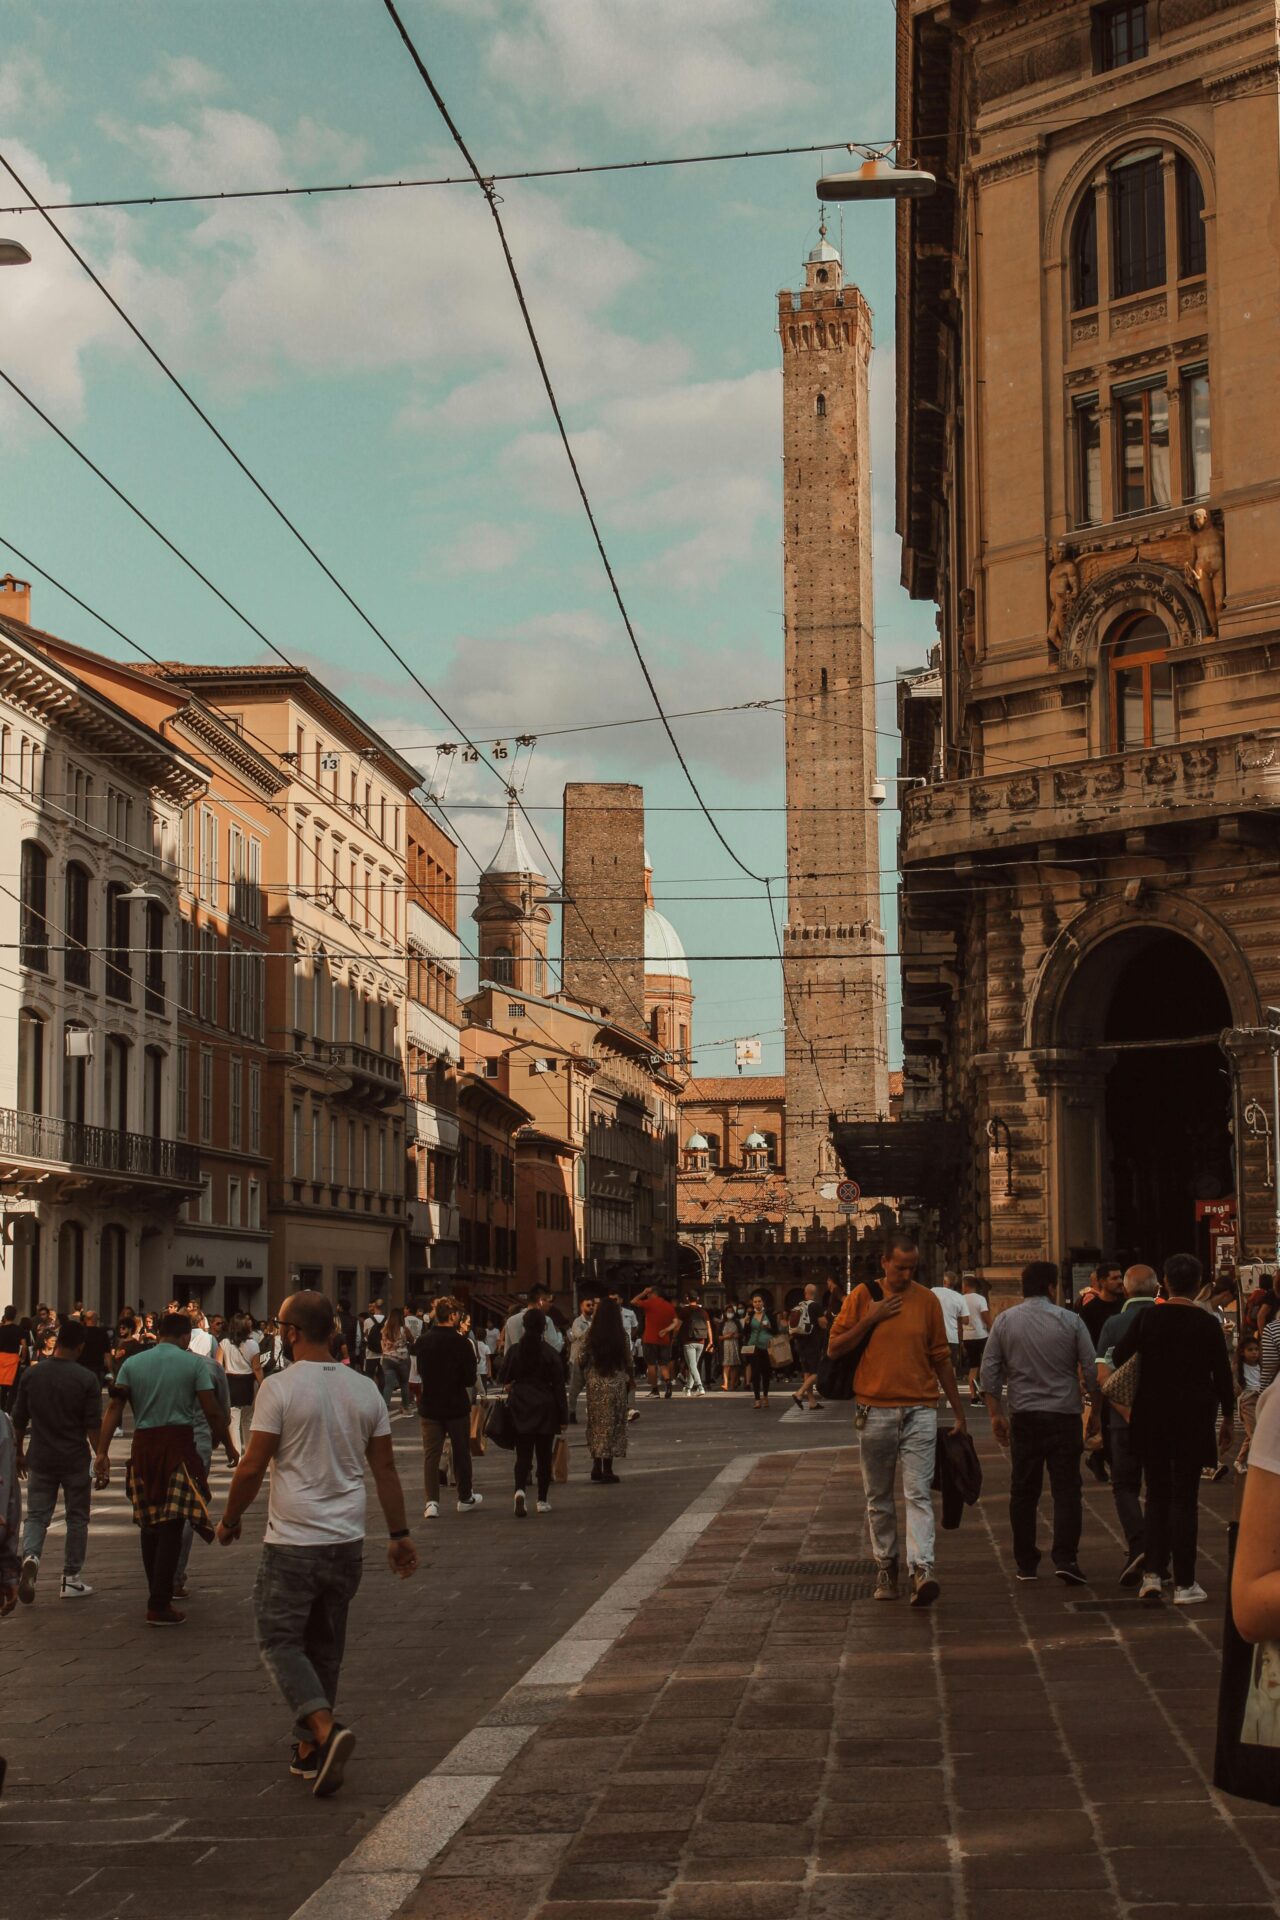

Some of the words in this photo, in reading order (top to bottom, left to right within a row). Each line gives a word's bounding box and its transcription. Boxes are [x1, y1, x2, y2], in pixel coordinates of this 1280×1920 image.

[462, 751, 479, 762] 14
[492, 748, 507, 759] 15
[321, 760, 338, 769] 13
